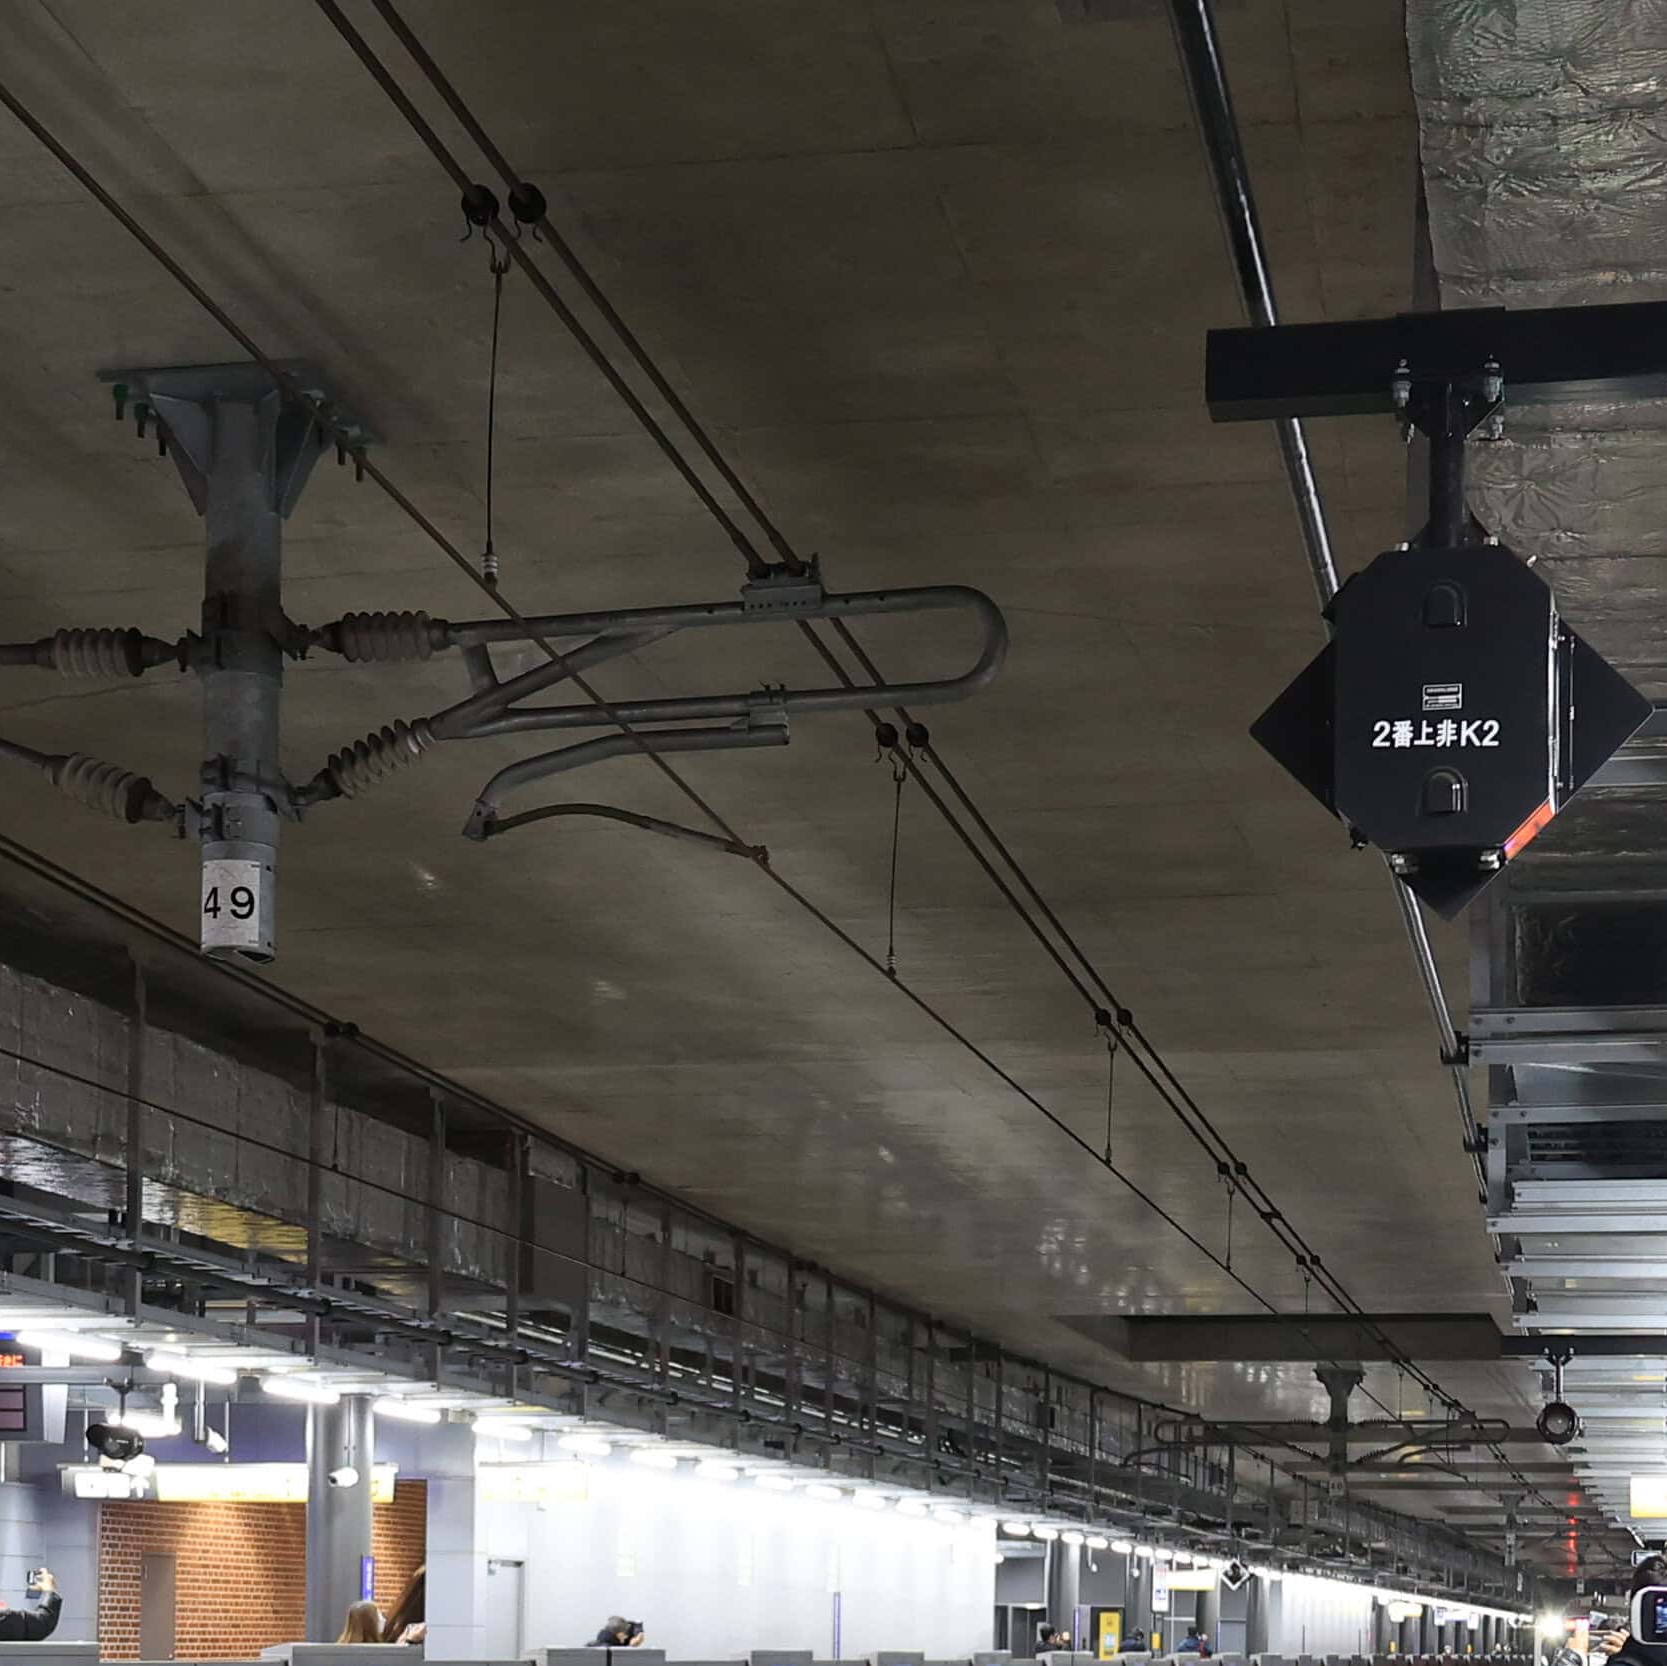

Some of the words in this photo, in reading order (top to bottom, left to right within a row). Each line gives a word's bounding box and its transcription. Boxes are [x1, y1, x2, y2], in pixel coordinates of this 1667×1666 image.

[1372, 718, 1500, 748] 2番上非K2
[203, 886, 255, 920] 49
